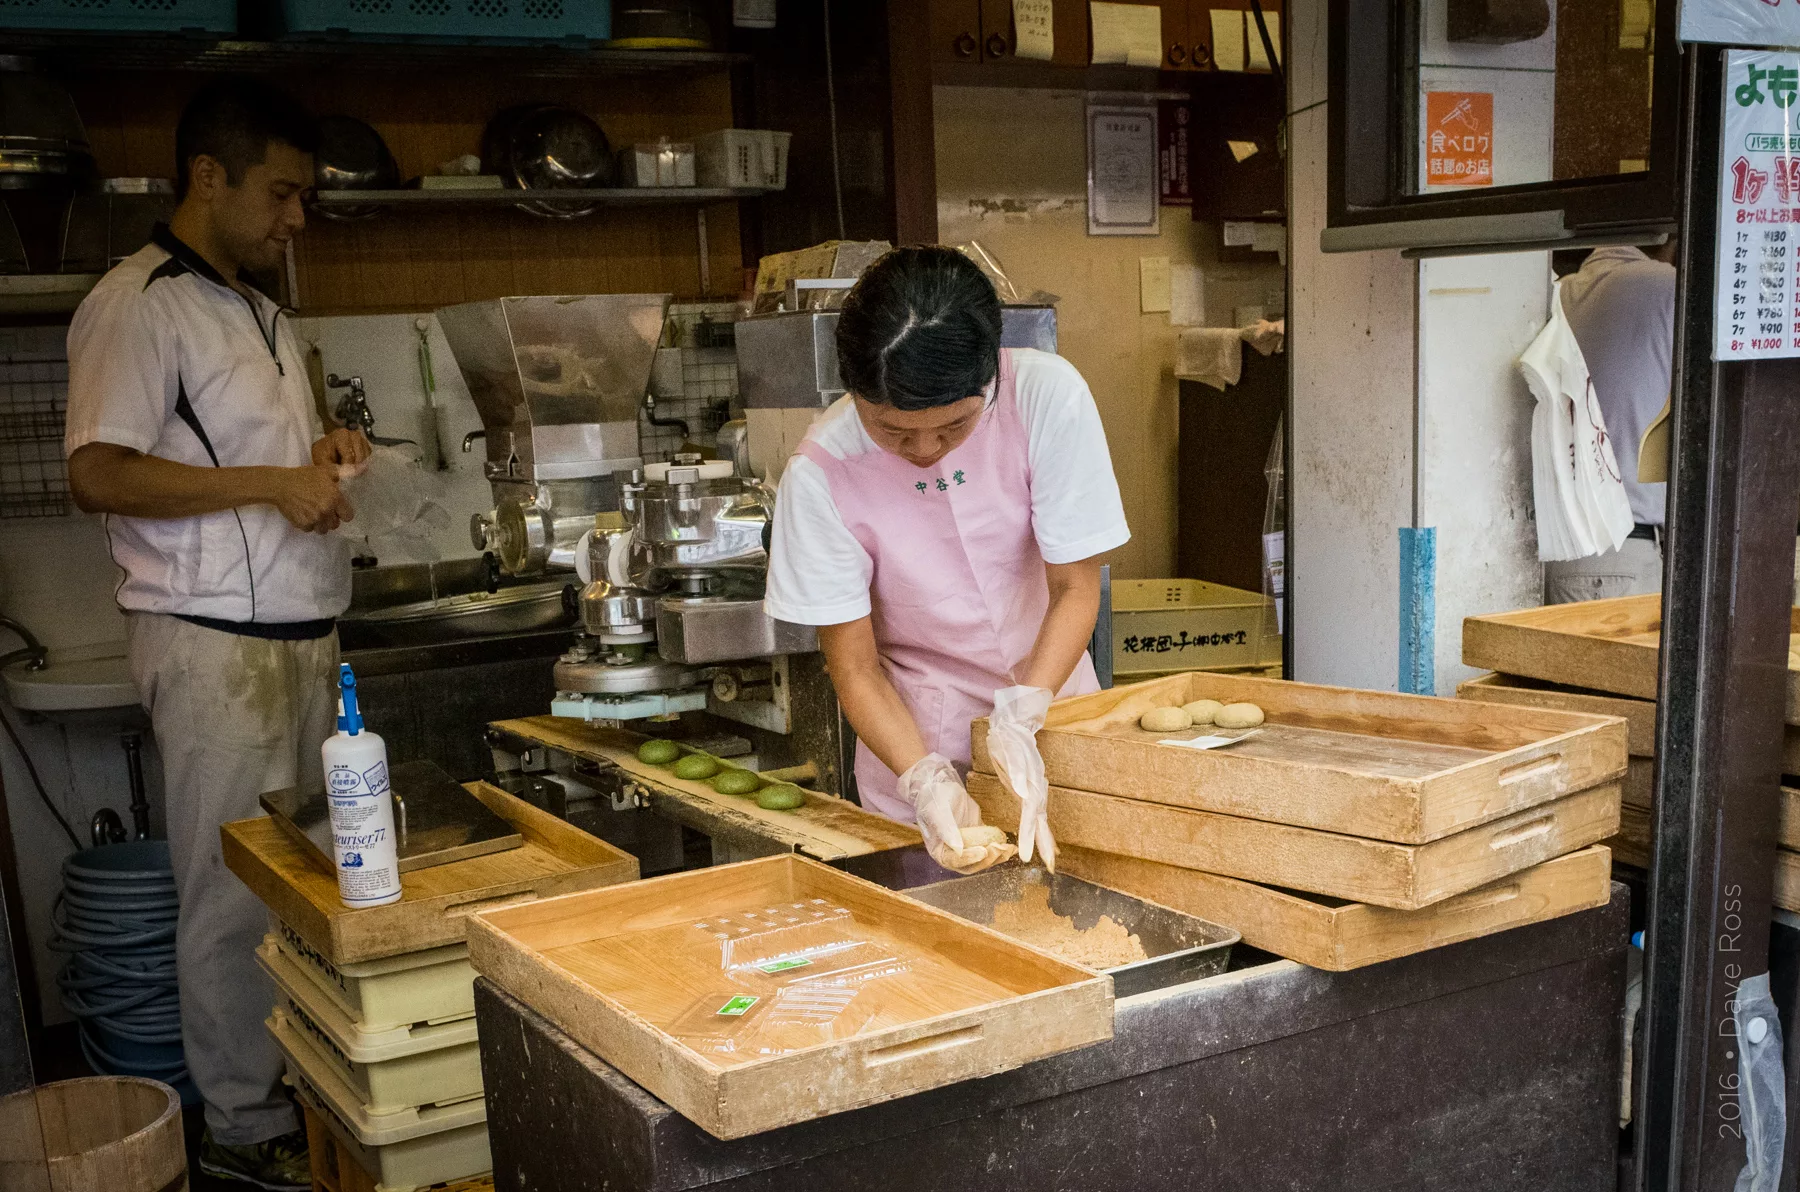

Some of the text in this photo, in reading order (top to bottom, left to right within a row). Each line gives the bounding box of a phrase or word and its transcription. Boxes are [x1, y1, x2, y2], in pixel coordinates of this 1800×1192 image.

[1735, 64, 1798, 109] よも
[1430, 129, 1490, 153] 食べログ
[1430, 158, 1489, 175] 話題のお店
[914, 469, 966, 494] 中谷堂
